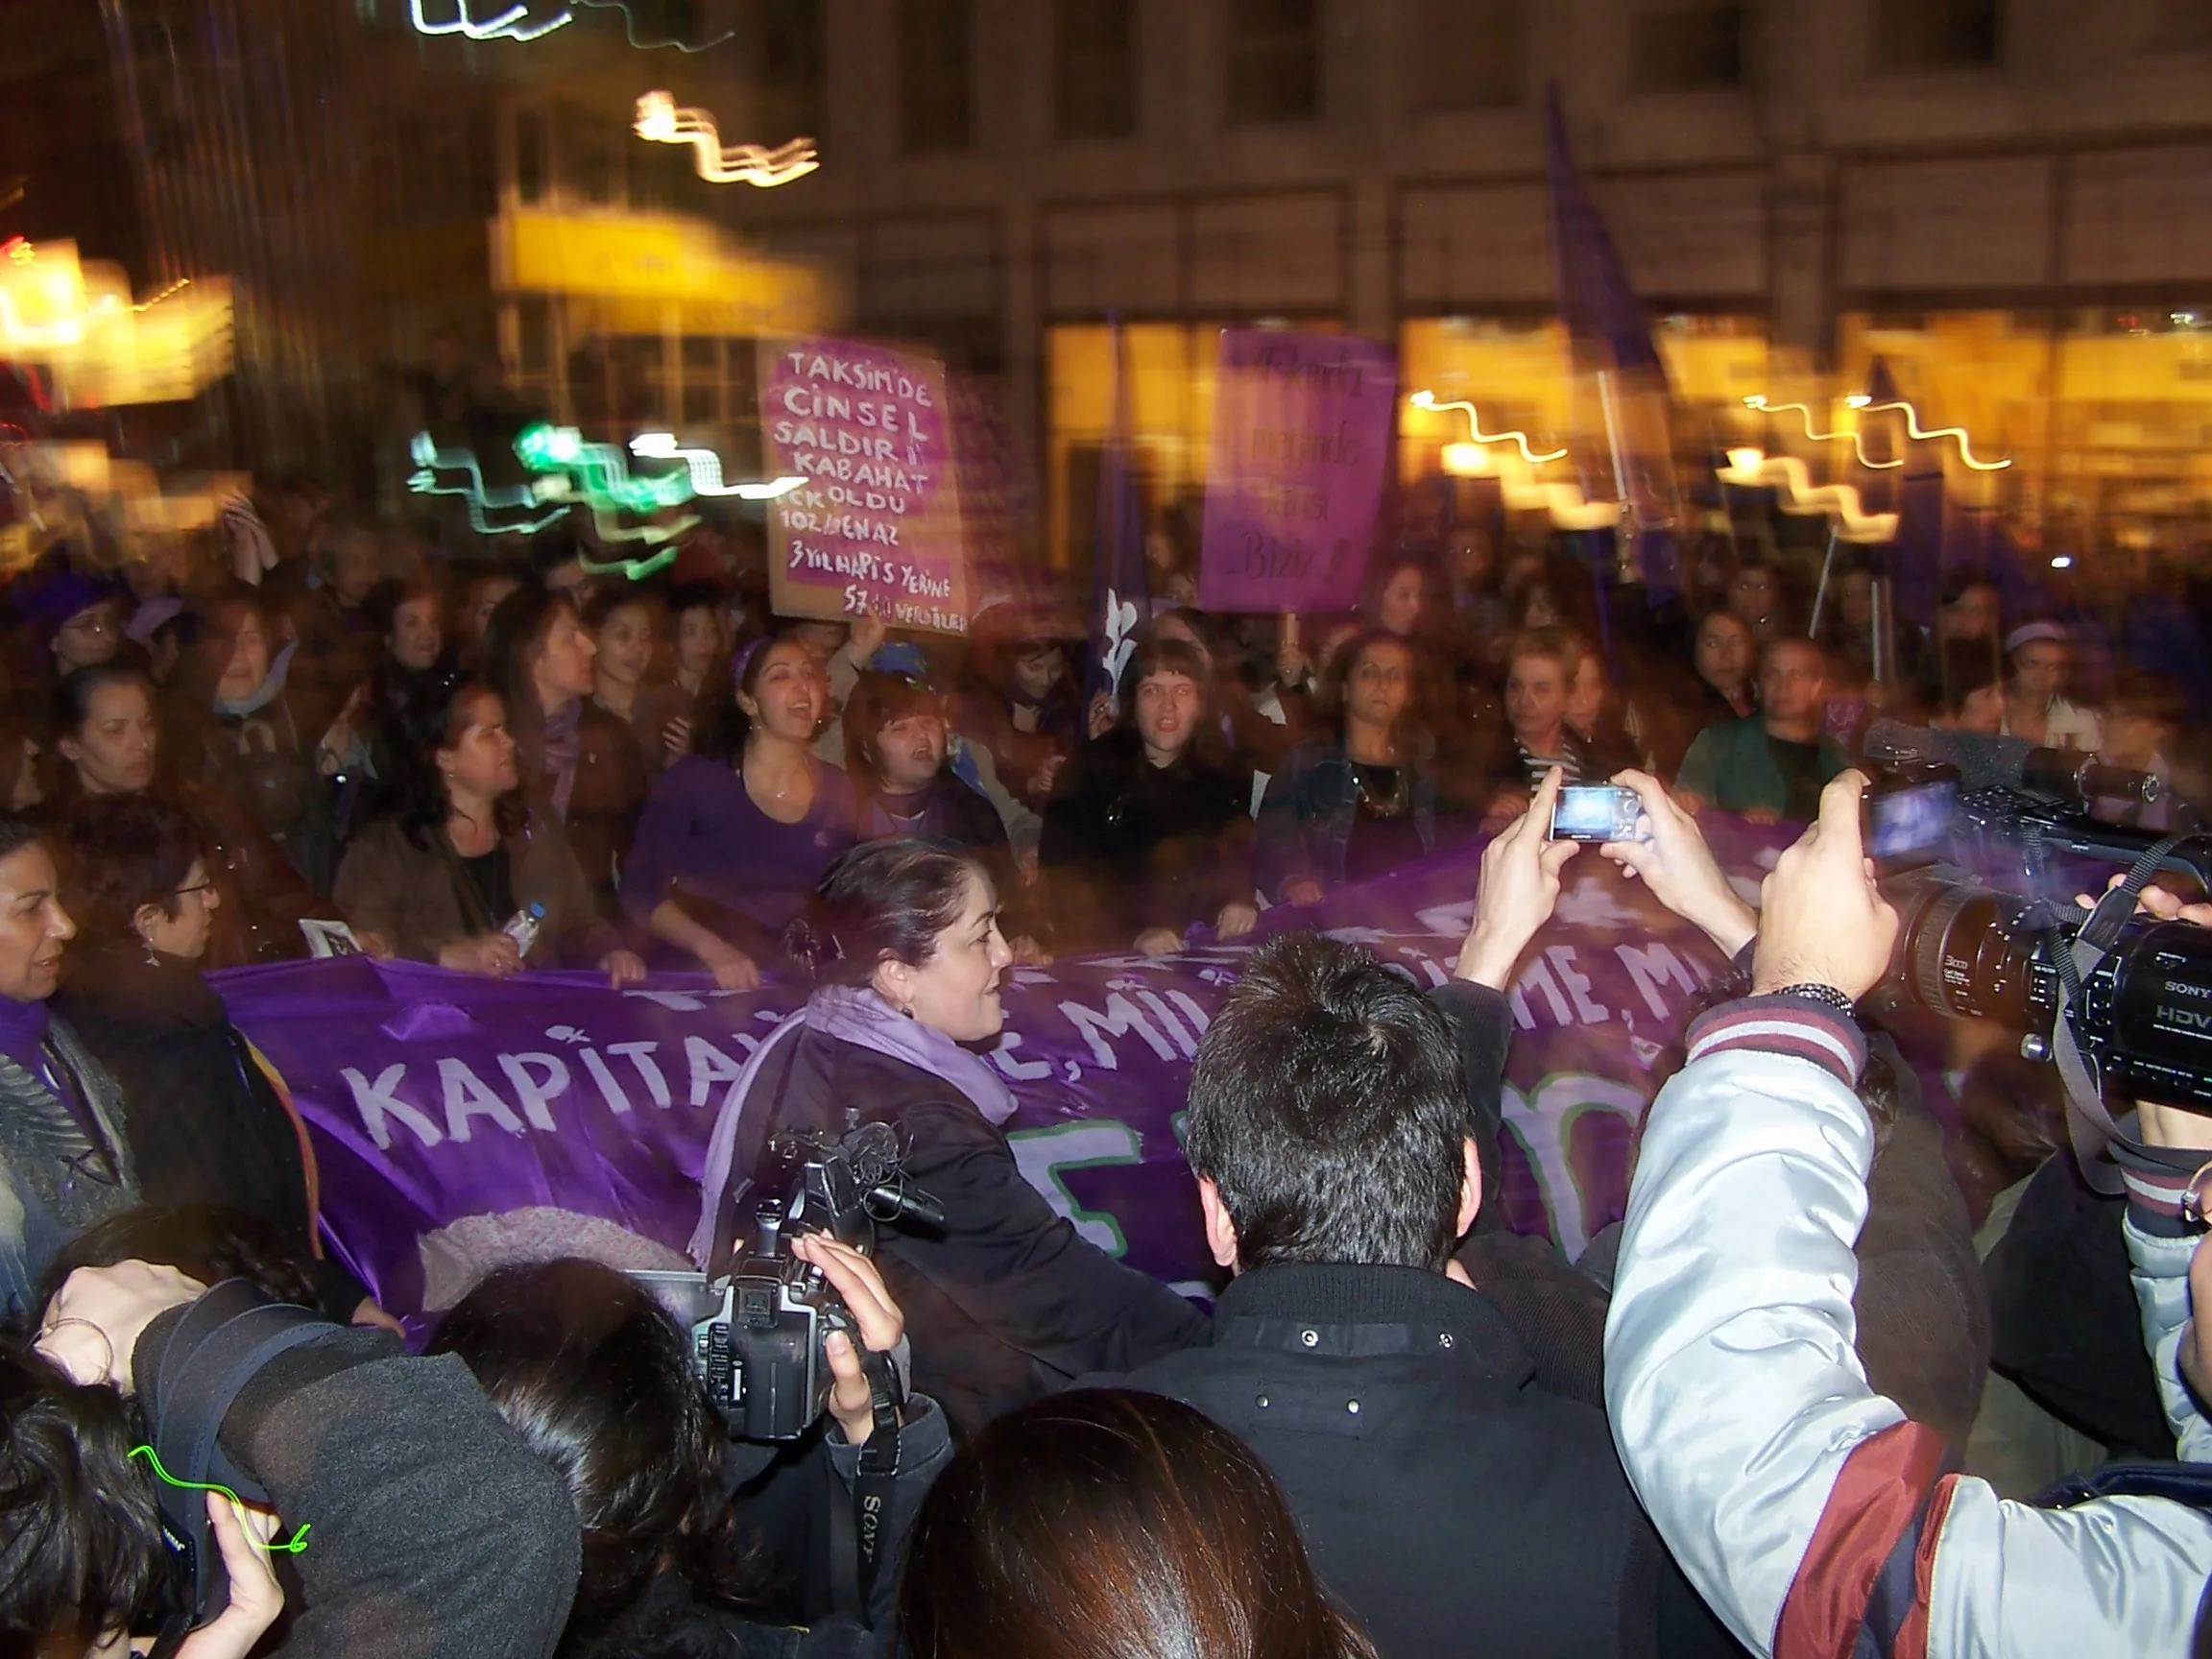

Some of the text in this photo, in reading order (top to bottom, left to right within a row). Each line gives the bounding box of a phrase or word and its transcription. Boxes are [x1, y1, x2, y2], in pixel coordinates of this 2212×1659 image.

[783, 383, 928, 442] CİNSEL
[793, 451, 928, 494] KABAHAT
[828, 486, 905, 514] OLDU
[789, 539, 805, 568] 3
[2164, 980, 2212, 999] SONY
[2156, 1004, 2212, 1029] HDV
[862, 1495, 881, 1556] SONY
